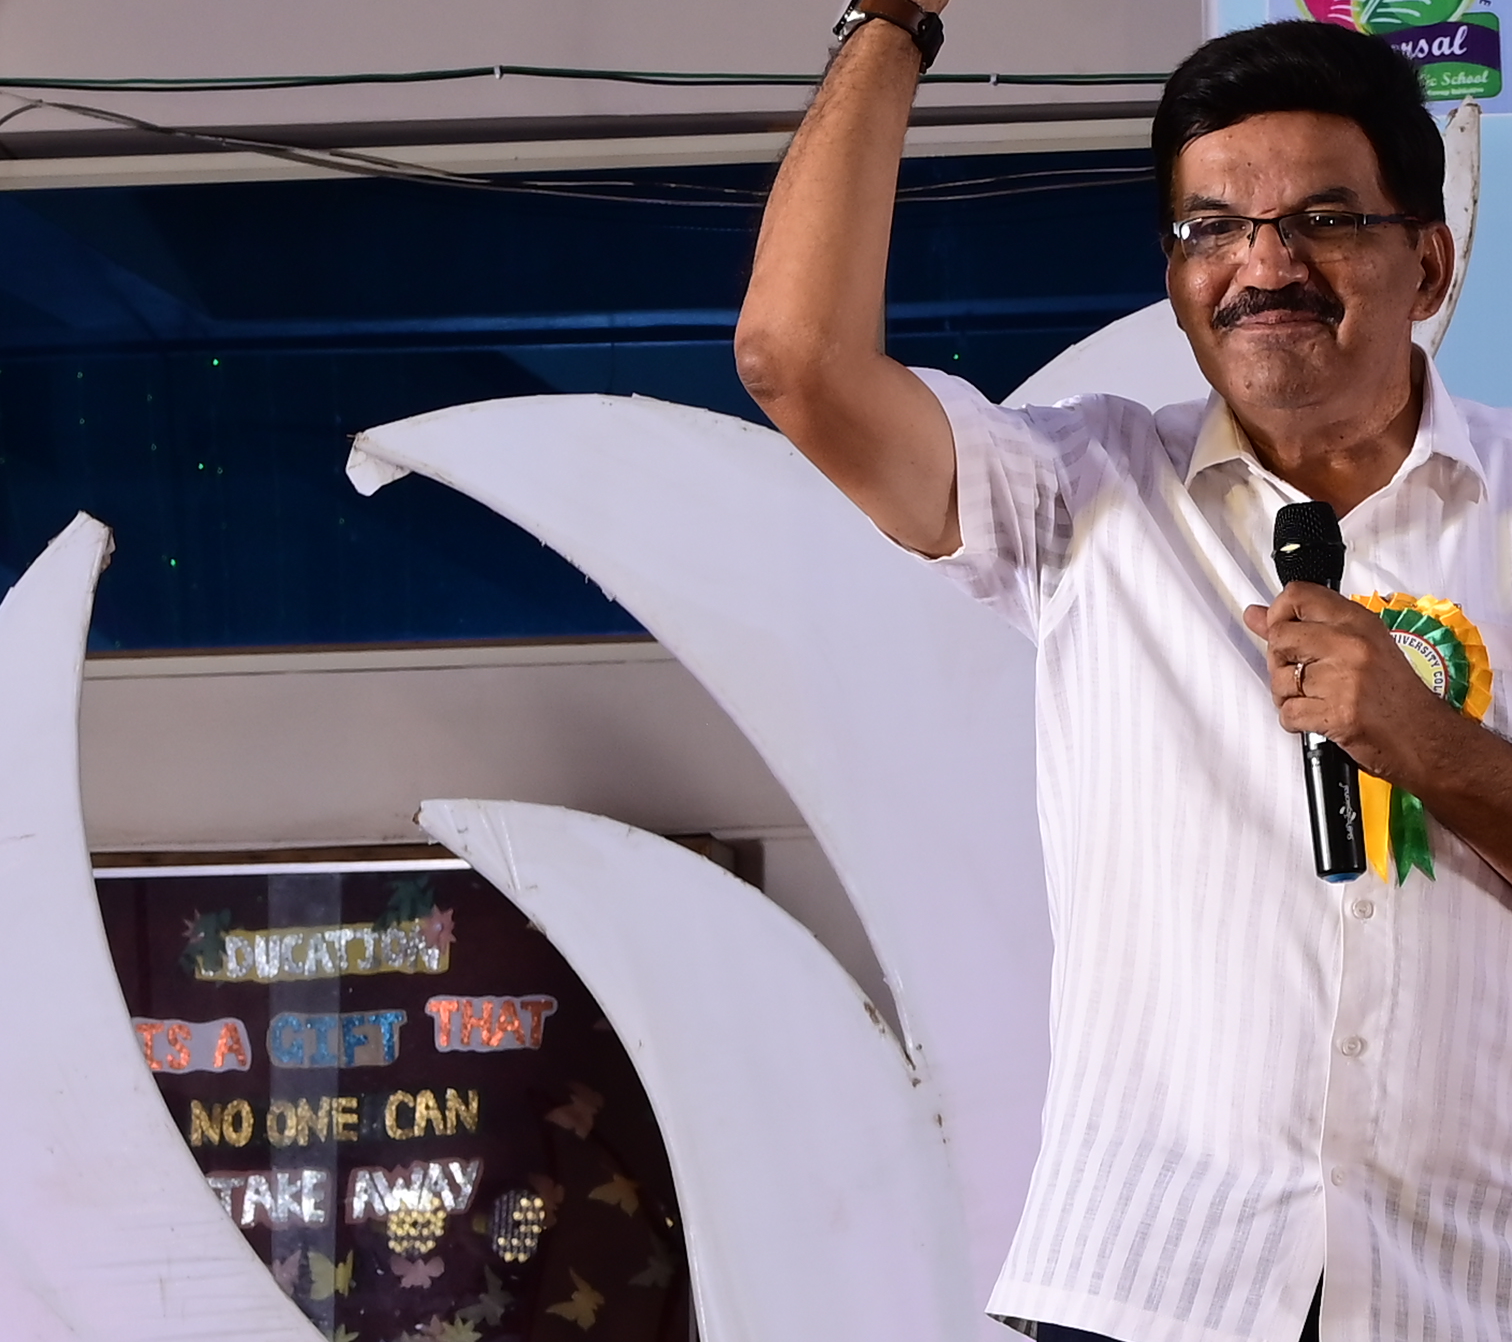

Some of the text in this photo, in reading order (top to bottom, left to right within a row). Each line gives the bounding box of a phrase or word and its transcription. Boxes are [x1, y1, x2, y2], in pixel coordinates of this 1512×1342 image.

[1441, 70, 1489, 86] School
[1394, 634, 1440, 668] IVERSITY
[197, 919, 443, 978] DUCATION
[134, 998, 554, 1071] IS A GIFT THAT
[190, 1089, 480, 1148] NO ONE CAN
[207, 1160, 482, 1225] TAKE AWAY
